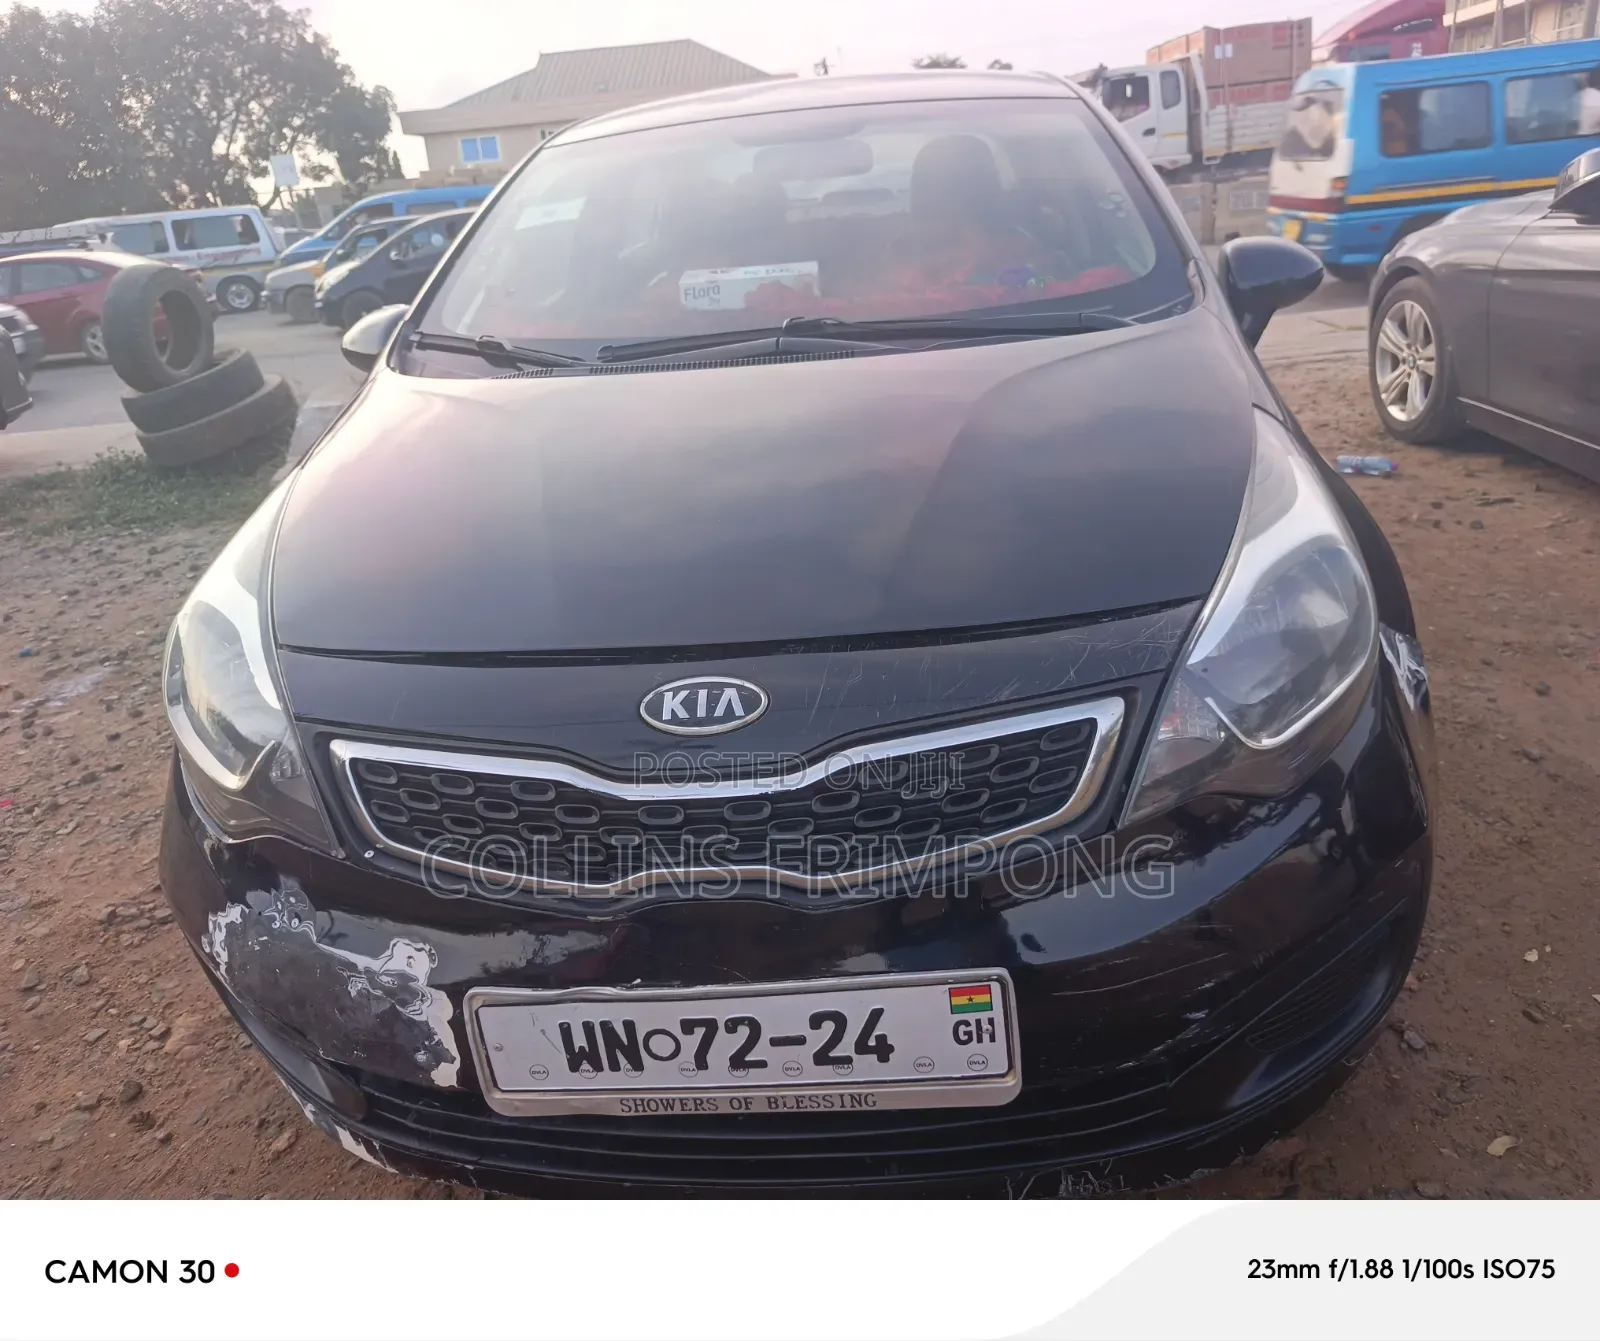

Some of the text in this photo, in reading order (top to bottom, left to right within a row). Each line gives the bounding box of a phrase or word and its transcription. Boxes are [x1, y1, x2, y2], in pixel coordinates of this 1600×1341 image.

[683, 284, 721, 302] Flora
[662, 687, 746, 720] KIA
[952, 1016, 997, 1046] GH
[620, 1092, 878, 1113] SHOWERS OF BLESSING
